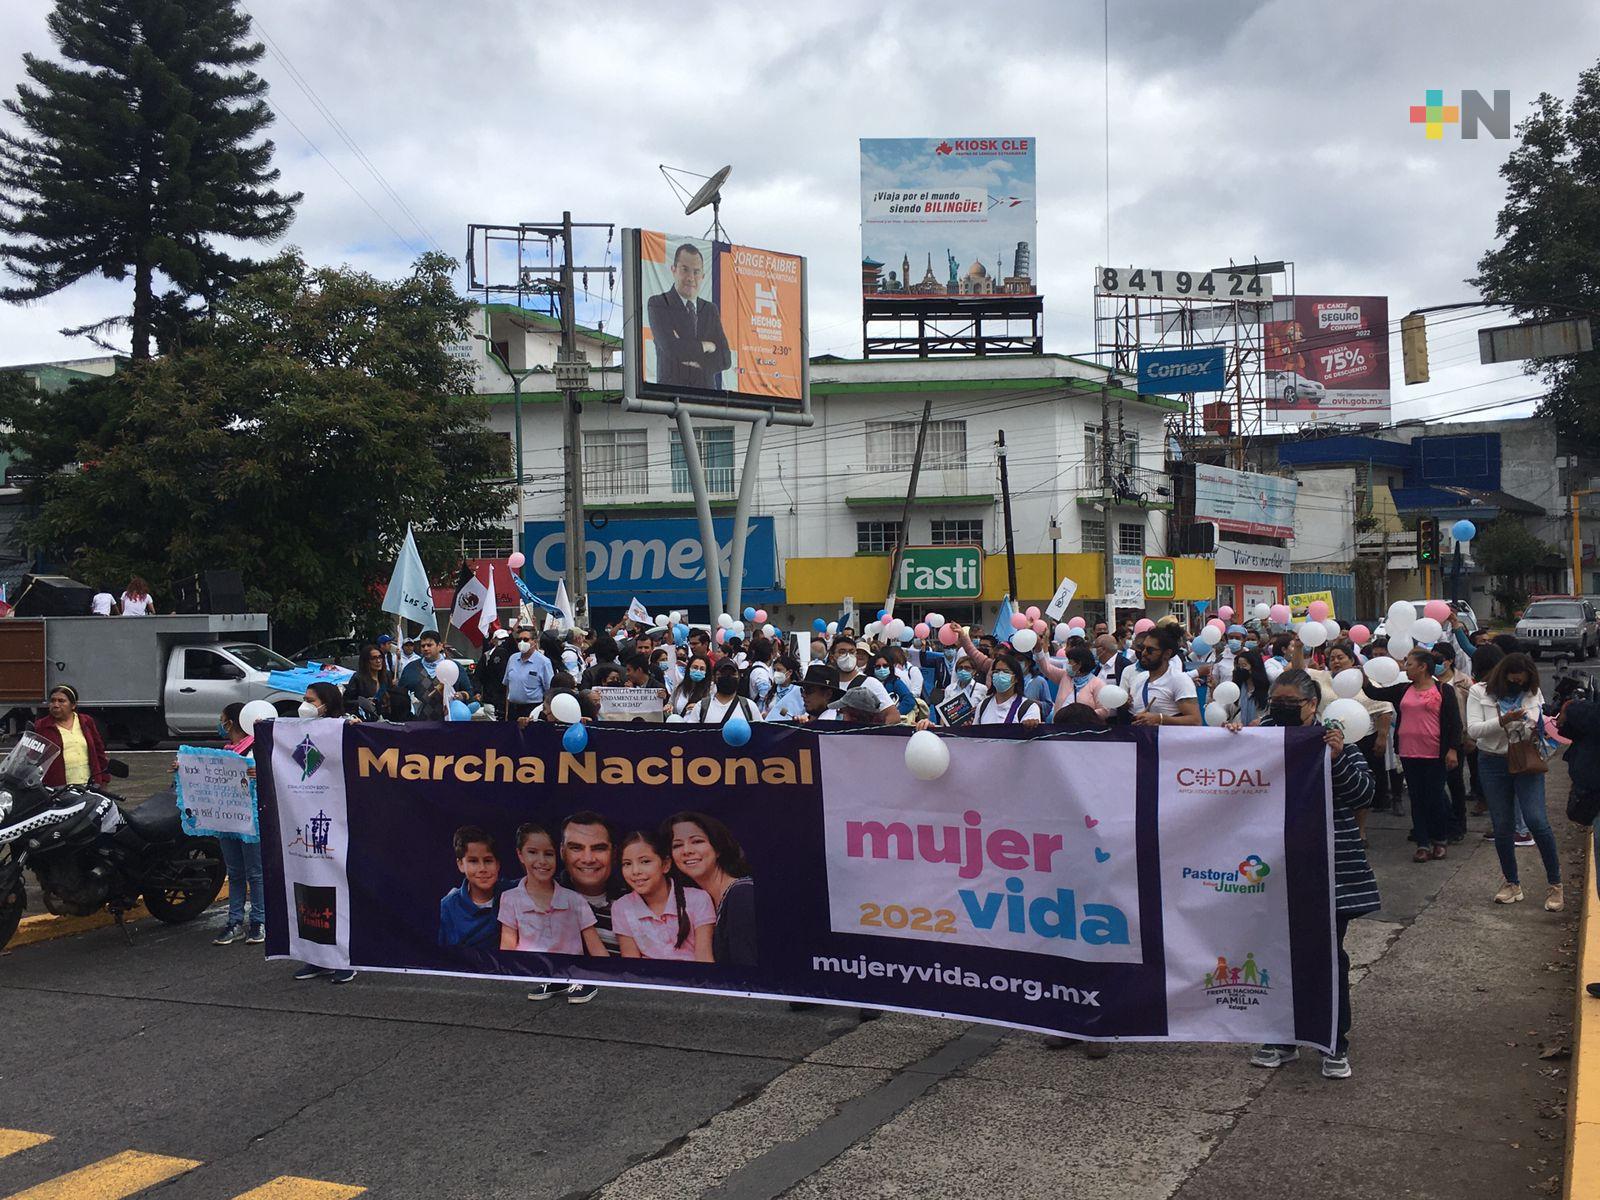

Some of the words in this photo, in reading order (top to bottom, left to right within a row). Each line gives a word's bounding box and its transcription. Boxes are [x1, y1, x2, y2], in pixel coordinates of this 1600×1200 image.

[955, 140, 998, 150] KIOSK
[1001, 140, 1028, 150] CLE
[874, 192, 900, 202] ¡Viaja
[903, 193, 918, 202] por
[920, 192, 929, 200] el
[931, 192, 960, 200] mundo
[889, 203, 921, 213] siendo
[924, 199, 983, 213] BILINGÜE!
[734, 251, 764, 268] JORGE
[765, 256, 797, 274] FAIBRE
[751, 315, 782, 328] HECHOS
[1321, 312, 1359, 322] SEGURO
[1328, 345, 1348, 354] HASTA
[1320, 348, 1365, 373] 75%
[1147, 358, 1213, 378] Comex
[1333, 365, 1368, 378] DESCUENTO
[1332, 397, 1383, 406] ovh.gob.mx
[1233, 549, 1251, 565] Vivir
[901, 558, 977, 590] fasti
[1146, 565, 1174, 591] fasti
[421, 601, 429, 611] 2
[357, 747, 545, 784] Marcha
[558, 746, 814, 786] Nacional
[846, 810, 1063, 880] mujer
[1182, 867, 1239, 882] Pastoral
[1215, 880, 1265, 894] Juvenil
[859, 902, 958, 935] 2022
[957, 877, 1130, 946] vida
[812, 953, 1100, 1008] mujeryvida.org.mx
[1206, 988, 1232, 996] FRENTE
[1233, 988, 1269, 996] NACIONAL
[1216, 997, 1260, 1005] FAMILIA
